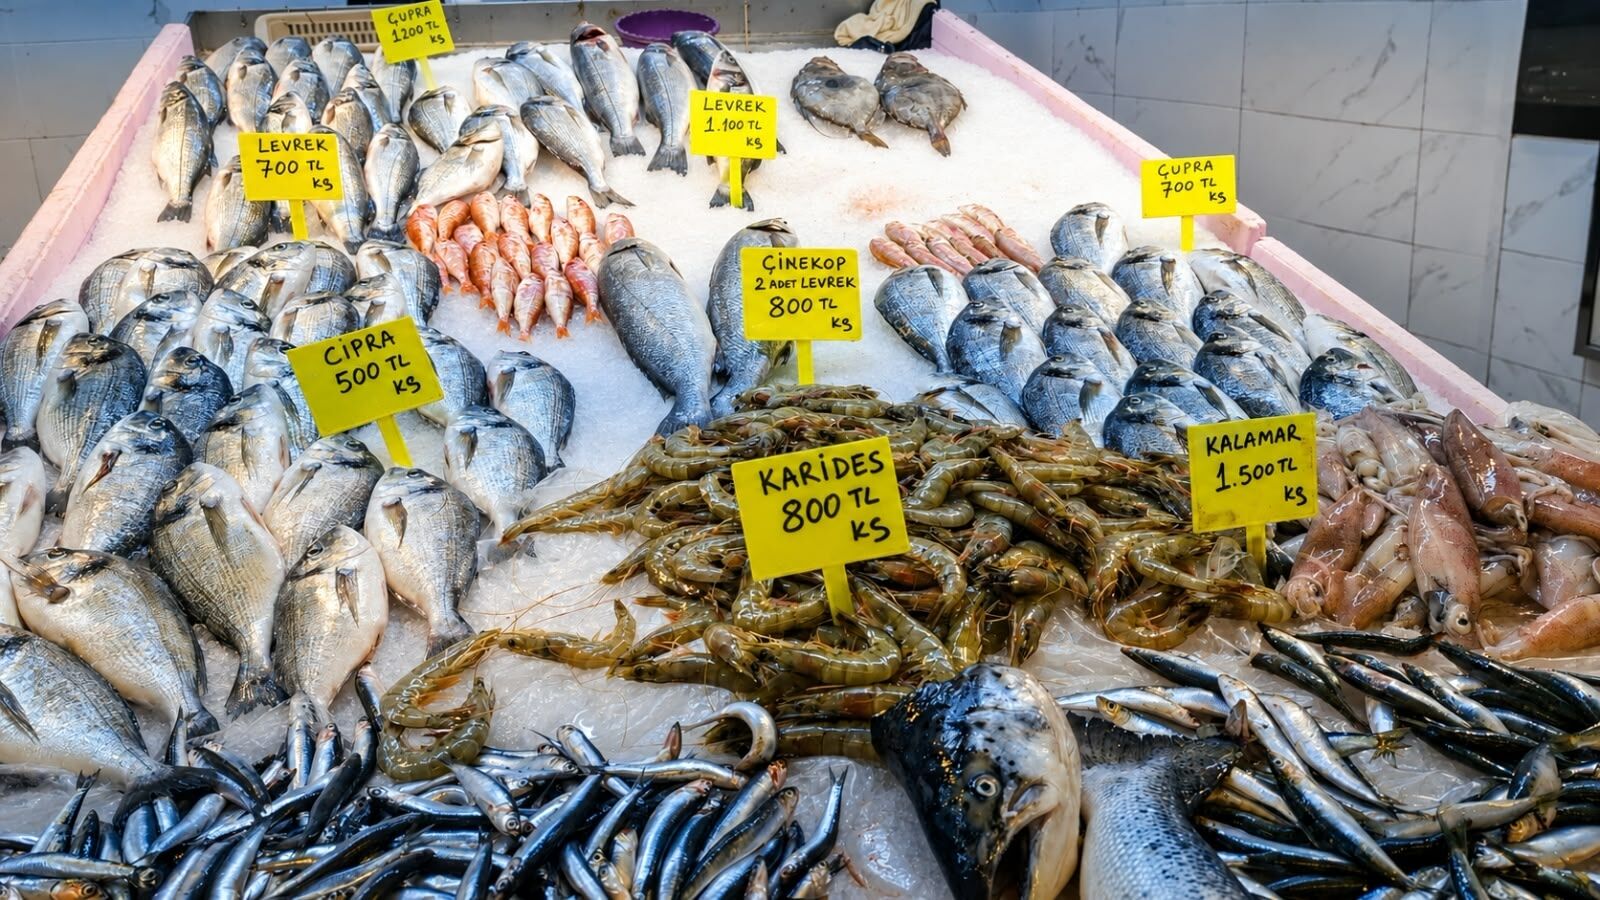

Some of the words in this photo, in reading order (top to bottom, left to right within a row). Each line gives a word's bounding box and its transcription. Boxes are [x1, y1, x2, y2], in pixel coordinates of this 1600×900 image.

[392, 25, 423, 43] 1200
[425, 21, 440, 30] TL
[703, 97, 766, 113] LEVREK
[704, 116, 744, 132] 1.100
[748, 120, 762, 130] TL
[258, 138, 328, 153] LEVREK
[256, 160, 299, 178] 700
[306, 160, 324, 171] TL
[1158, 160, 1213, 180] ÇUPRA
[1161, 180, 1194, 198] 700
[1200, 178, 1217, 188] TL
[762, 252, 846, 275] ÇİNEKOP
[754, 277, 766, 290] 2
[769, 279, 797, 289] ADET
[801, 276, 857, 289] LEVREK
[769, 296, 813, 318] 800
[818, 298, 838, 310] TL
[335, 362, 380, 394] 500
[385, 354, 410, 371] TL
[1206, 424, 1301, 457] KALAMAR
[759, 450, 884, 496] KARİDES
[1277, 457, 1298, 473] TL
[782, 493, 841, 533] 800
[847, 486, 880, 508] TL
